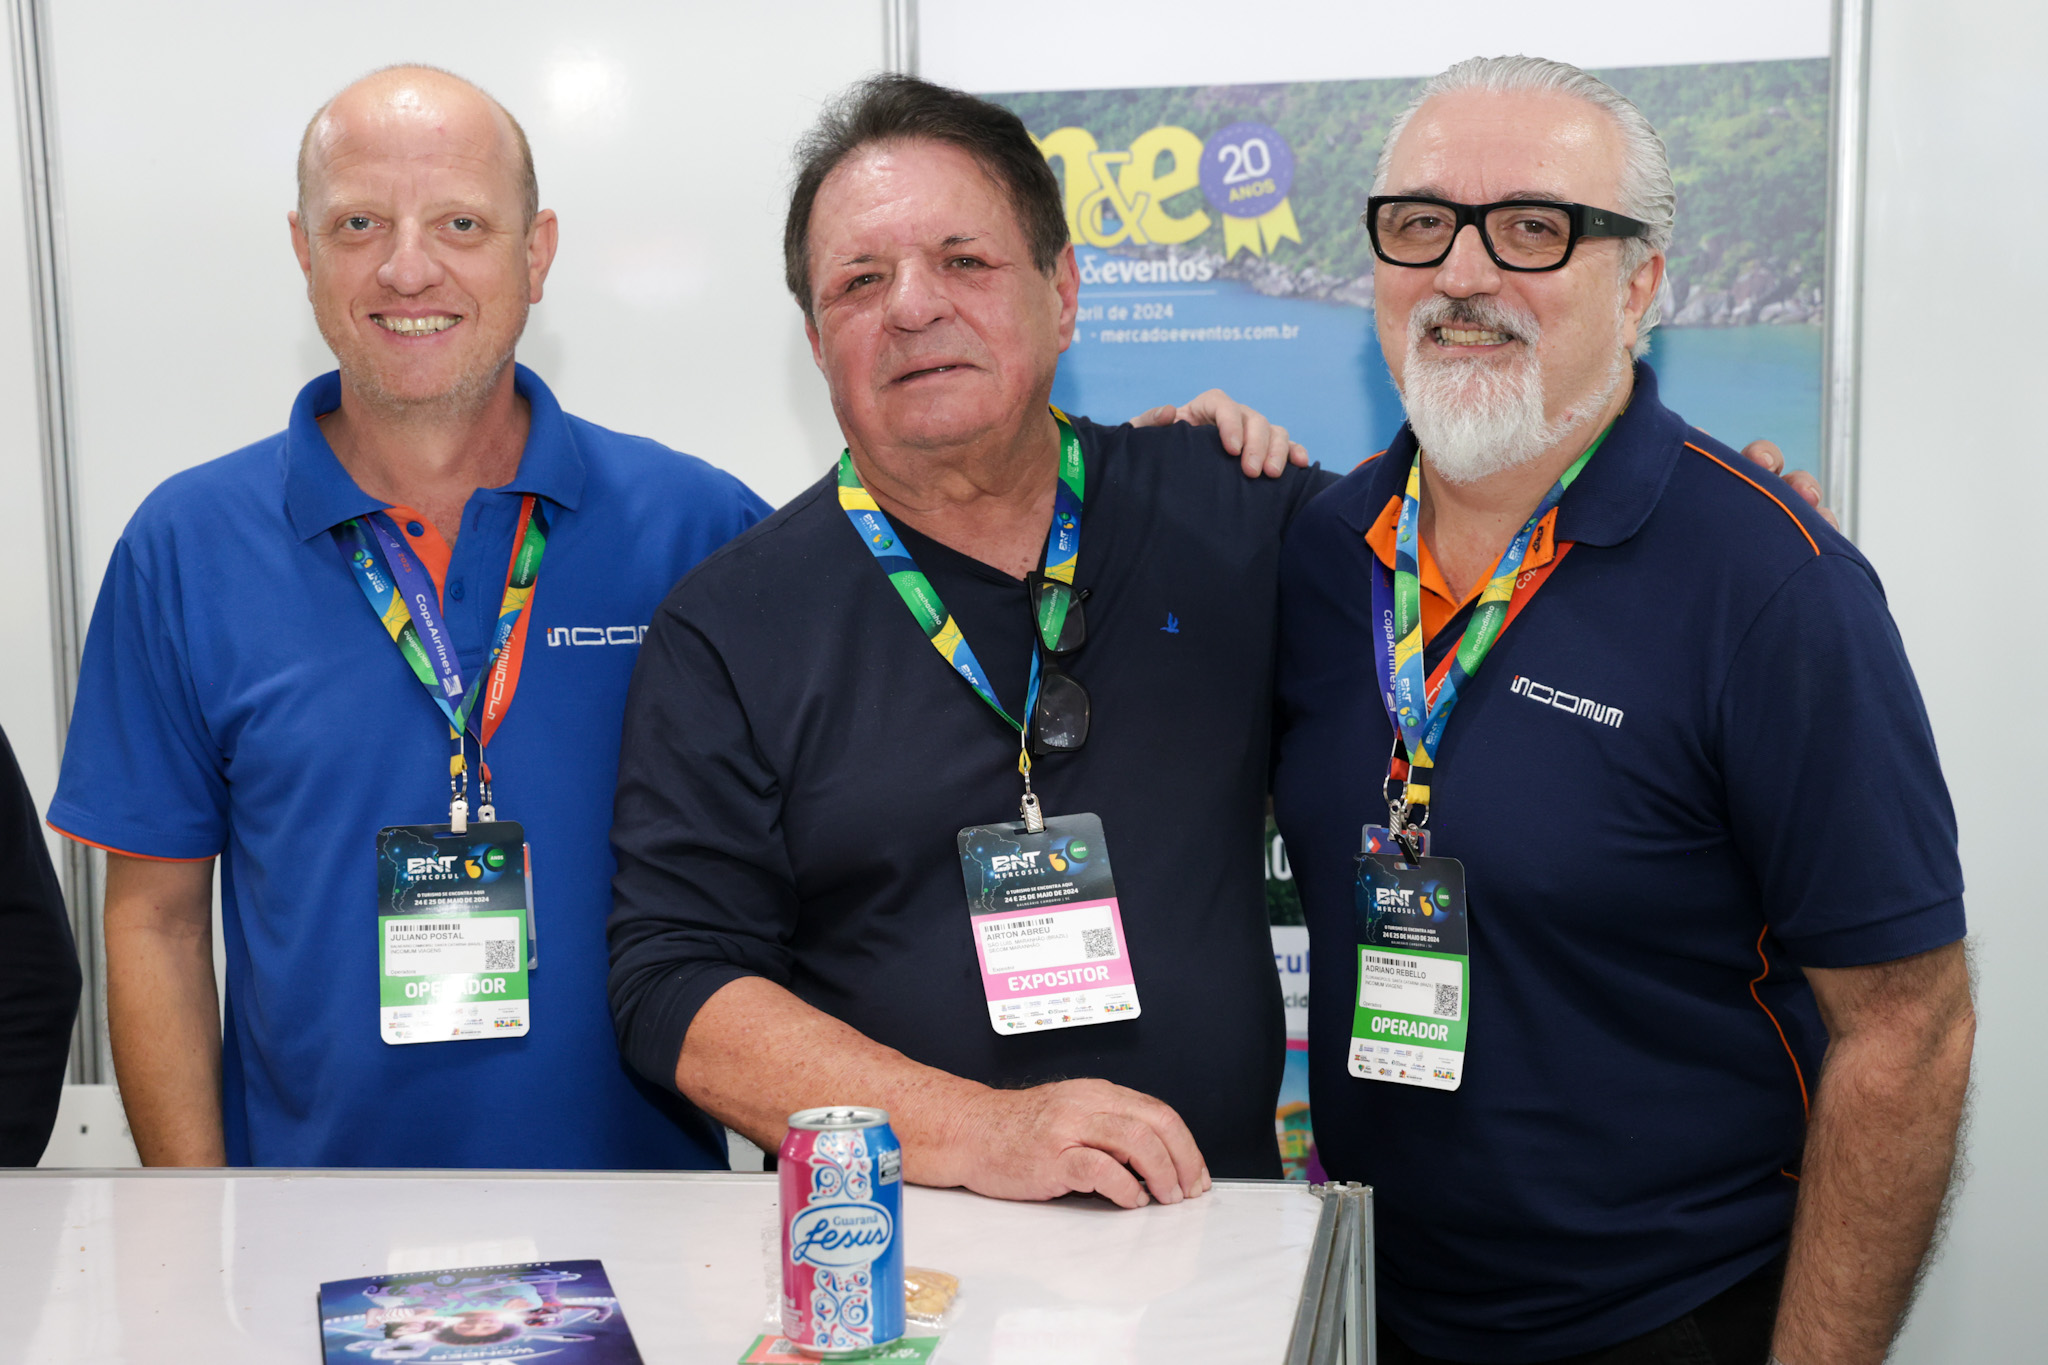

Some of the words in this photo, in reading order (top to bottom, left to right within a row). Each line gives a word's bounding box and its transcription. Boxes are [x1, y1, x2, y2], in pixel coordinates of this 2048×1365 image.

[1218, 138, 1270, 184] 20
[1228, 178, 1275, 203] ANOS
[1076, 304, 1103, 321] bril
[1107, 304, 1128, 320] de
[1133, 303, 1174, 320] 2024
[1101, 323, 1299, 344] mercadoeeventos.com.br
[914, 587, 942, 626] machadinho
[1472, 605, 1494, 652] machadinho
[404, 630, 432, 669] machadinho
[1401, 678, 1412, 703] BNT
[407, 856, 458, 874] BNT
[992, 851, 1040, 872] BNT
[994, 869, 1045, 879] MERCOSUL
[1376, 888, 1414, 906] BNT
[1377, 906, 1416, 914] MERCOSUL
[987, 931, 1018, 941] AIRTON
[1021, 927, 1050, 936] ABREU
[1008, 965, 1110, 992] EXPOSITOR
[1366, 965, 1395, 975] ADRIANO
[1396, 969, 1426, 979] REBELLO
[405, 978, 506, 998] OPEDOR
[1371, 1016, 1448, 1042] OPERADOR
[833, 1214, 878, 1227] Guaraná
[792, 1218, 889, 1262] Jesus
